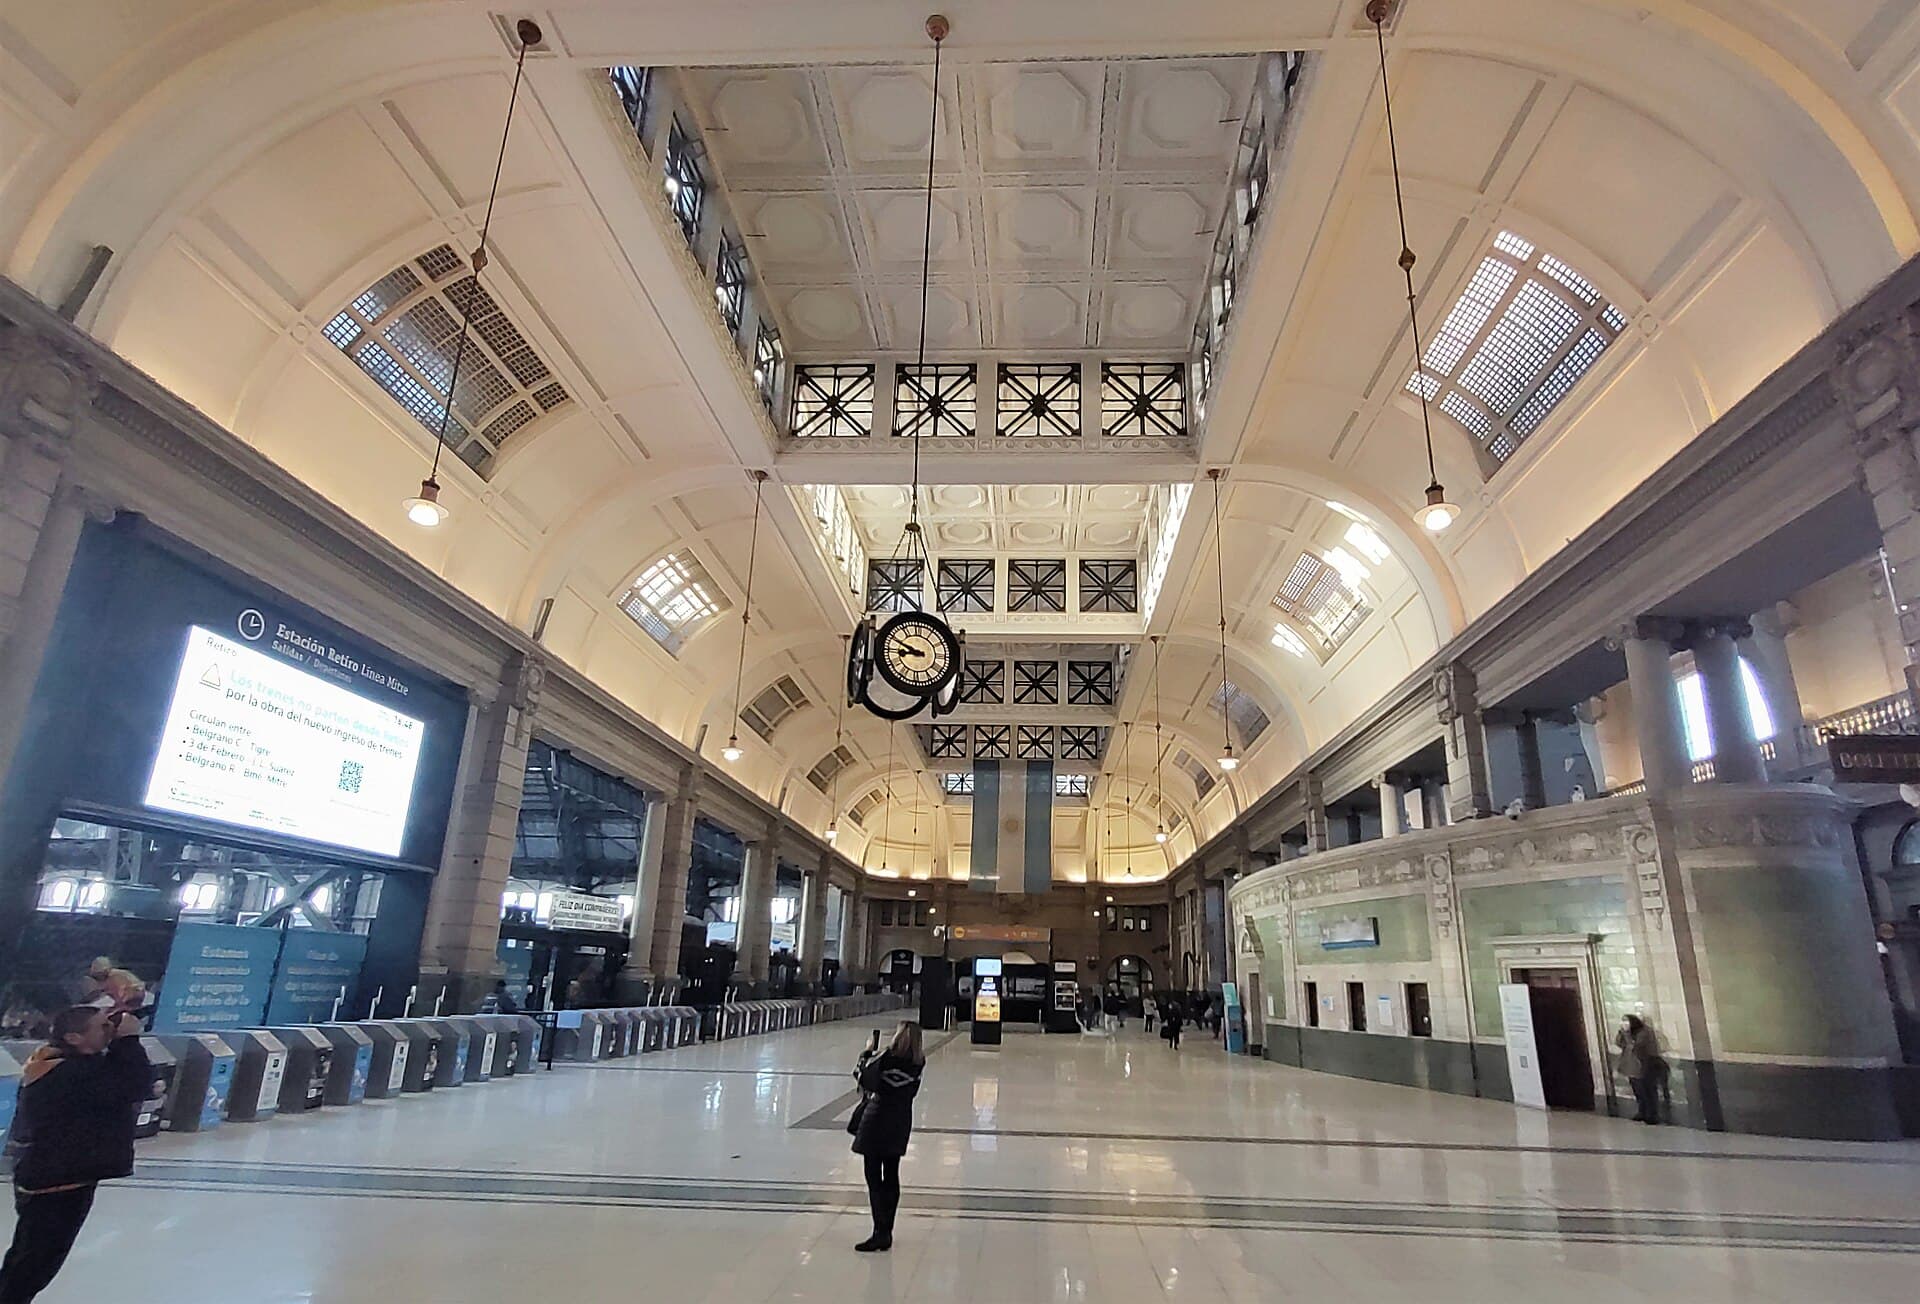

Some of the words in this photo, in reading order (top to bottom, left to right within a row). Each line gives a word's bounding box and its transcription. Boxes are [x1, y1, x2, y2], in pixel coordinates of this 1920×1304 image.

[207, 636, 237, 657] Retiro
[271, 640, 303, 662] Salidas
[276, 624, 325, 656] Estación
[327, 647, 359, 672] Retiro
[361, 664, 385, 685] Línea
[386, 676, 409, 696] Mitre
[189, 710, 227, 730] Circulan
[228, 723, 252, 737] entre
[226, 687, 246, 702] por
[248, 693, 258, 707] la
[260, 702, 283, 718] obra
[286, 709, 302, 724] del
[303, 717, 332, 734] nuevo
[334, 728, 366, 746] ingreso
[367, 739, 378, 750] de
[379, 744, 403, 759] trenes
[192, 724, 233, 744] Belgrano
[185, 752, 227, 771] Belgrano
[196, 741, 209, 752] de
[210, 744, 245, 762] Febrero
